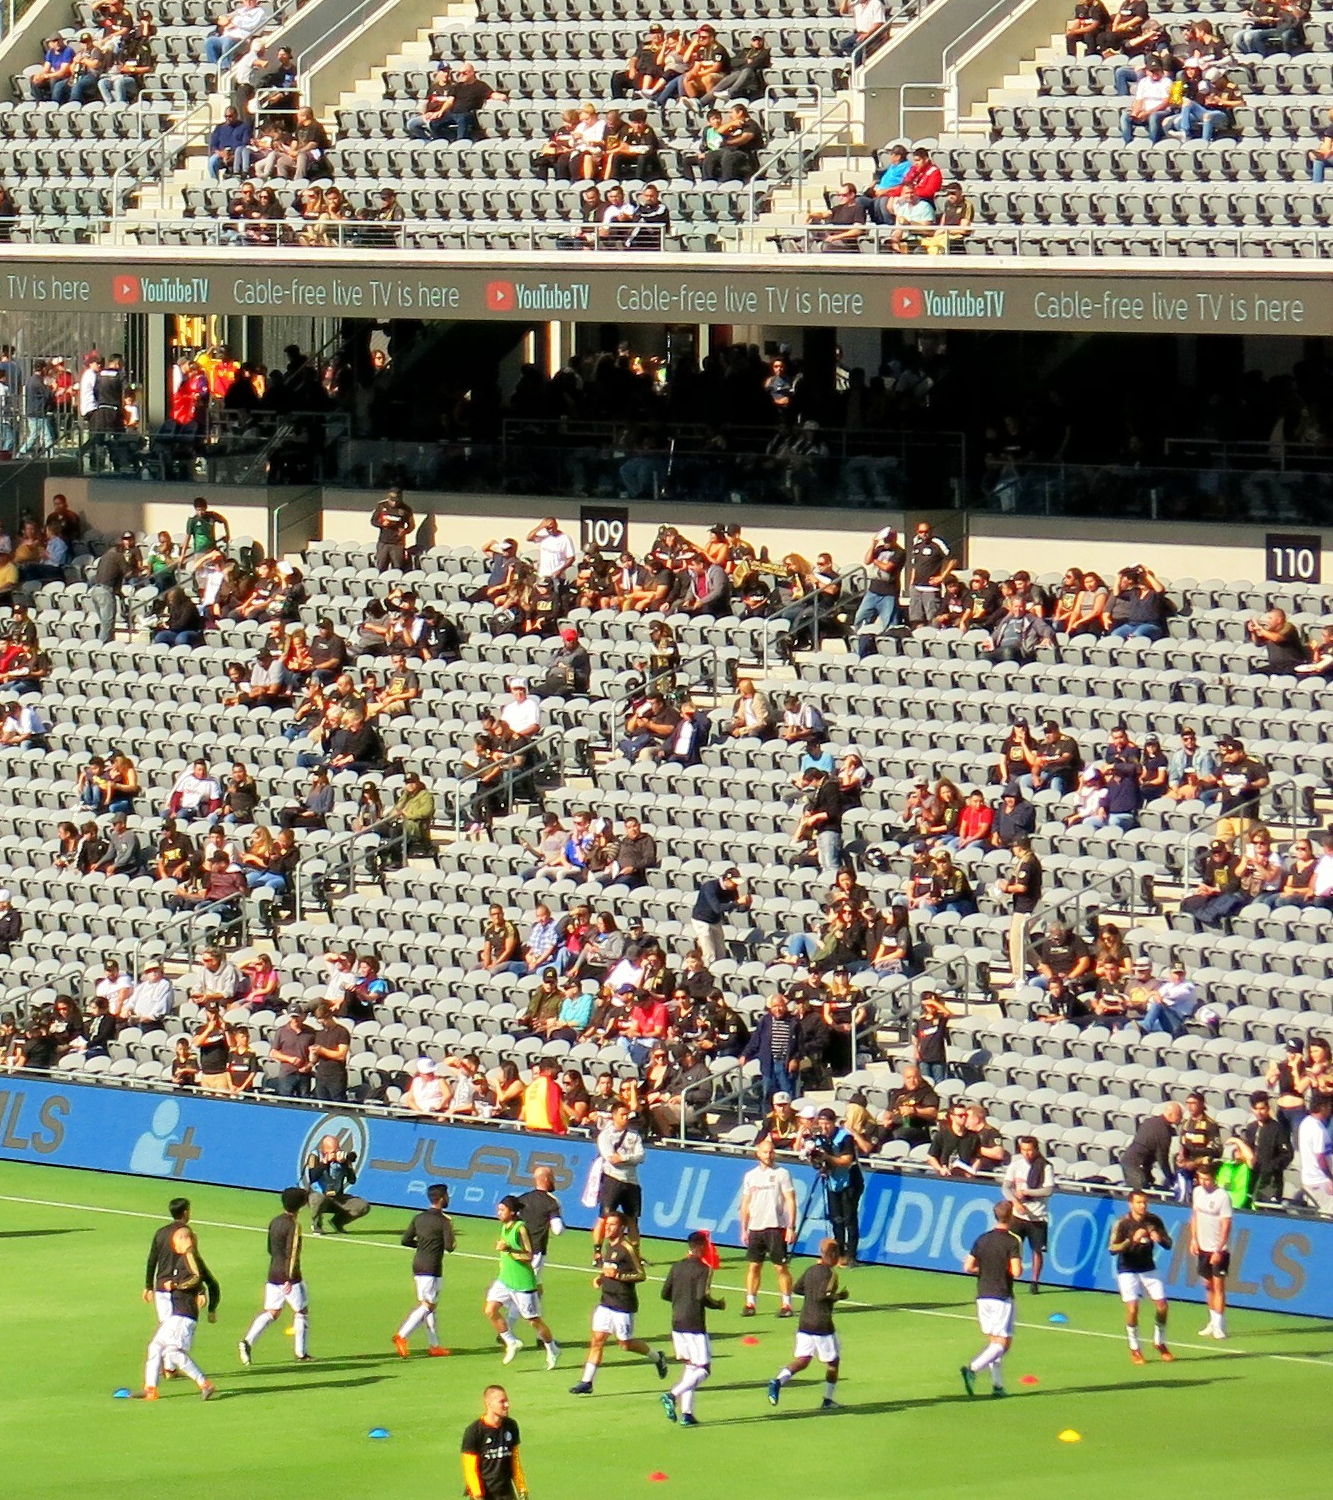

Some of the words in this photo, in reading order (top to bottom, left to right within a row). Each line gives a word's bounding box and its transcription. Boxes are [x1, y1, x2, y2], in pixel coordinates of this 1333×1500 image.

[7, 275, 28, 299] TV
[32, 275, 46, 300] is
[52, 276, 90, 300] here
[233, 278, 327, 306] Cable-free
[333, 279, 363, 306] live
[369, 281, 392, 306] TV
[398, 280, 413, 307] is
[418, 281, 459, 308] here
[616, 284, 717, 312] Cable-free
[724, 285, 757, 313] live
[764, 287, 790, 313] TV
[796, 287, 811, 313] is
[819, 288, 864, 315] here
[1034, 291, 1143, 320] Cable-free
[1152, 292, 1188, 320] live
[1196, 293, 1222, 321] TV
[1231, 293, 1247, 321] is
[1254, 295, 1304, 322] here
[584, 519, 624, 547] 109
[1273, 548, 1314, 578] 110
[369, 1138, 574, 1191] JLAB
